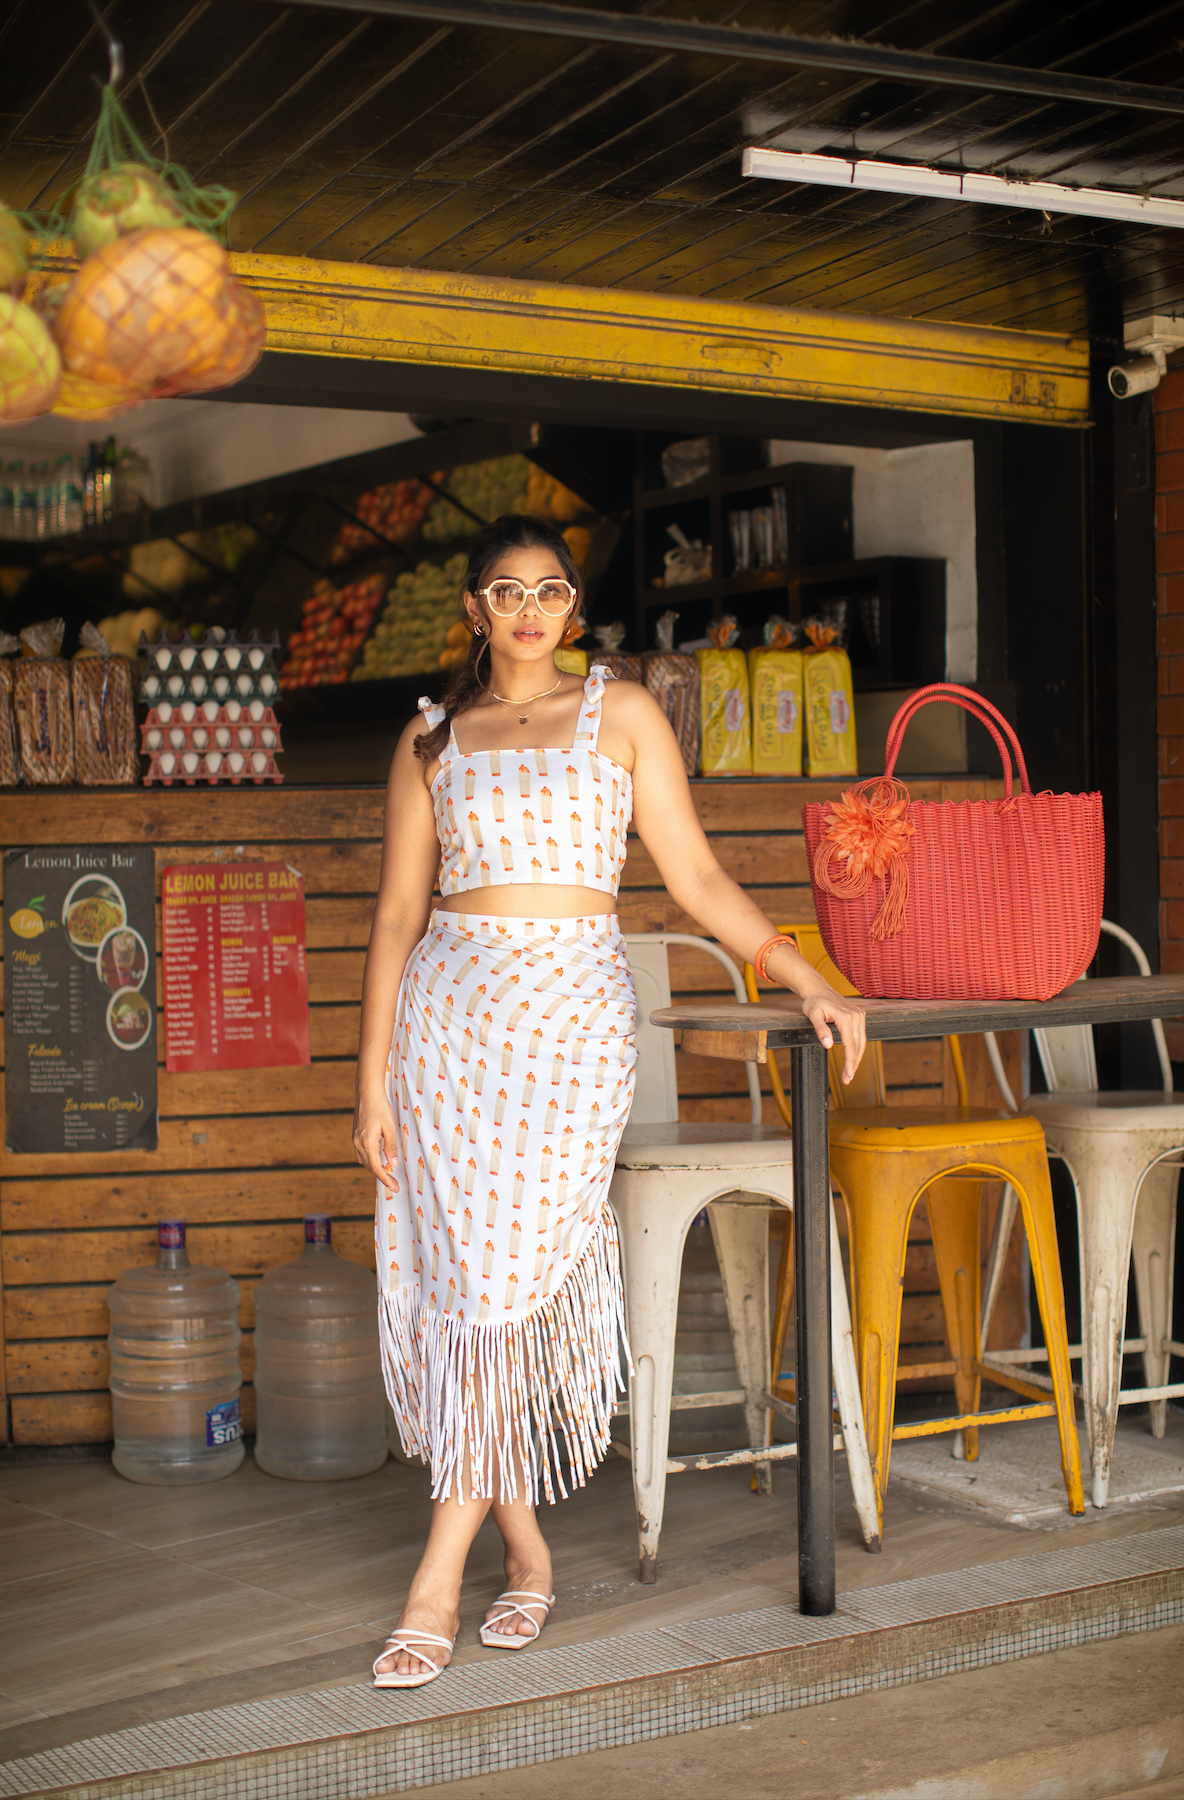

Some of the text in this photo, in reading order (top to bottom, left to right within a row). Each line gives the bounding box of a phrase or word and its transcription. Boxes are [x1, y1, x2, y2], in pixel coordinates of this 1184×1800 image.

[25, 853, 135, 870] Lemon Juice Bar
[166, 871, 298, 893] LEMON JUICE BAR
[12, 949, 41, 966] Maggi
[63, 1098, 78, 1112] Ice
[80, 1102, 106, 1111] cream
